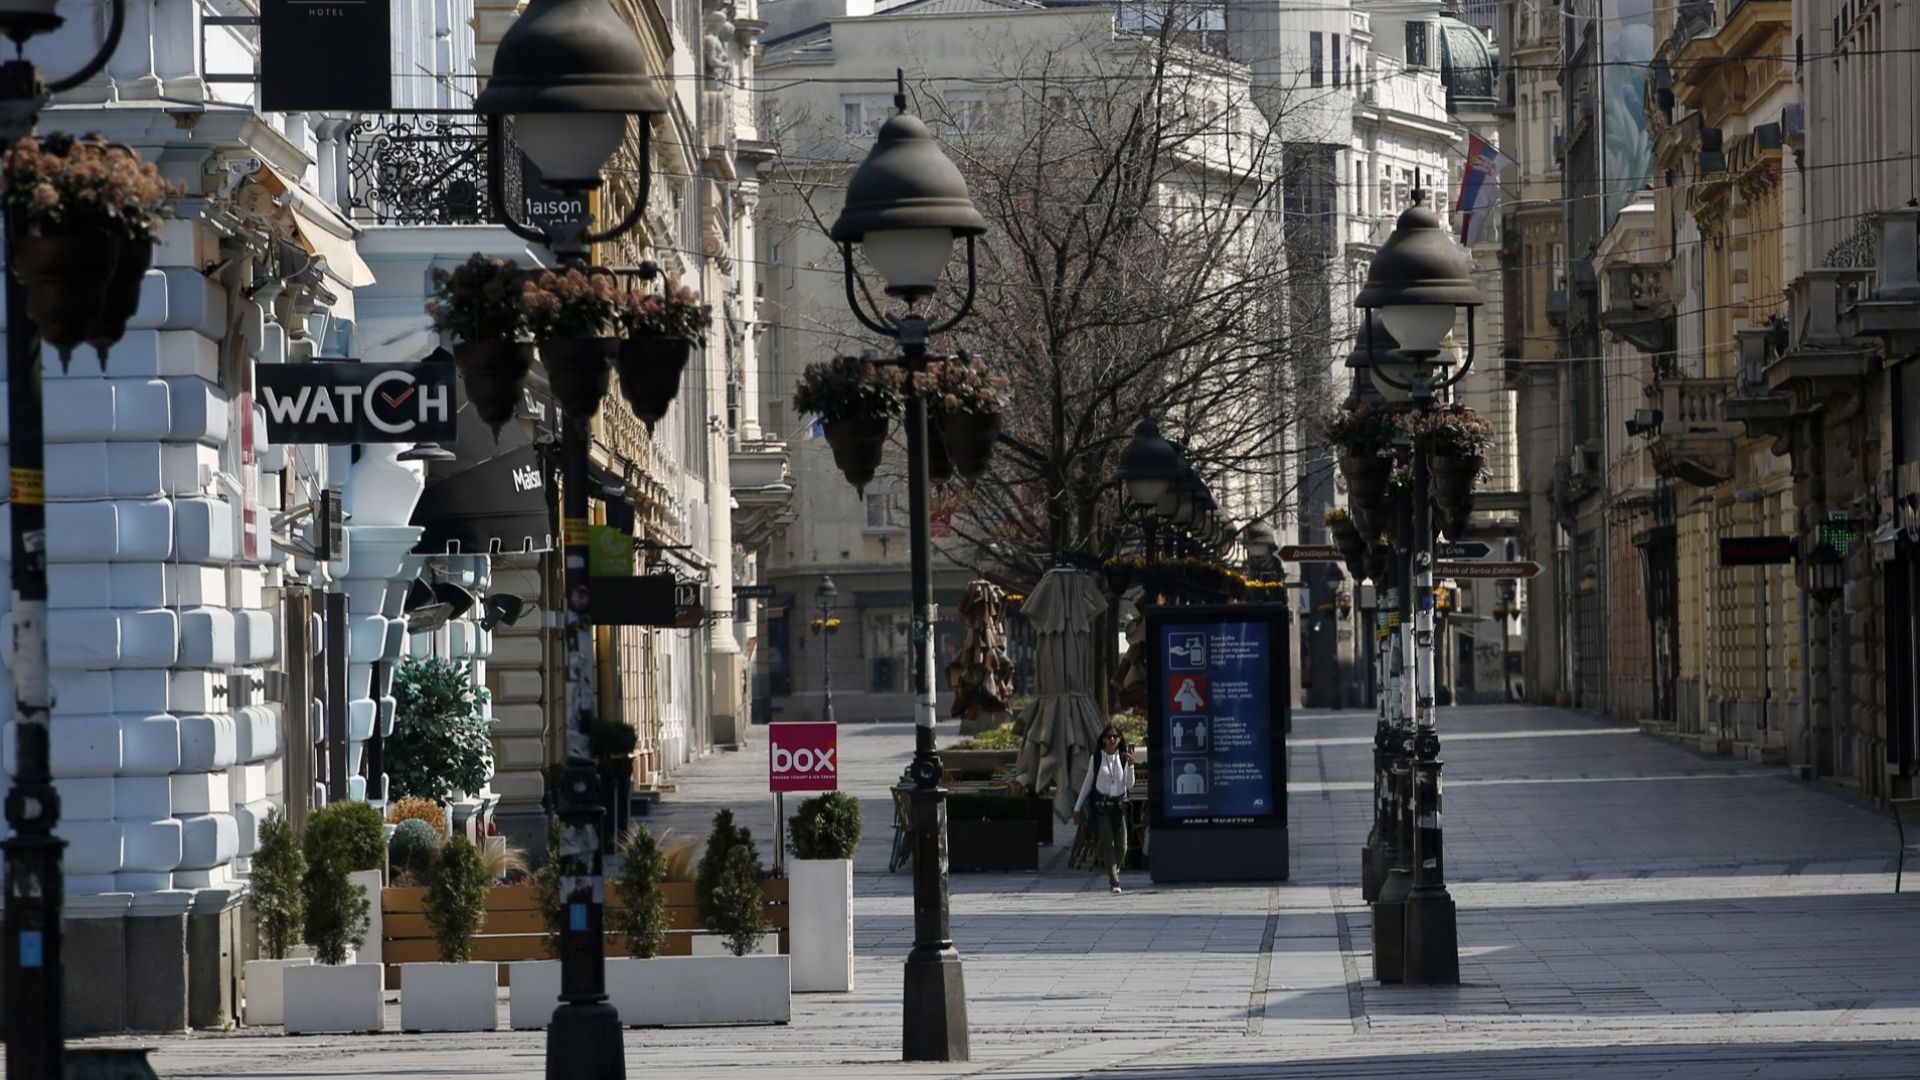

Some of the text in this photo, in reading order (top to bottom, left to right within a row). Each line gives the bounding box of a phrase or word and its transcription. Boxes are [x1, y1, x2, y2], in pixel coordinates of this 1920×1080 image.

[309, 8, 344, 17] HOTEL
[263, 370, 447, 434] WATCH
[772, 742, 835, 772] box
